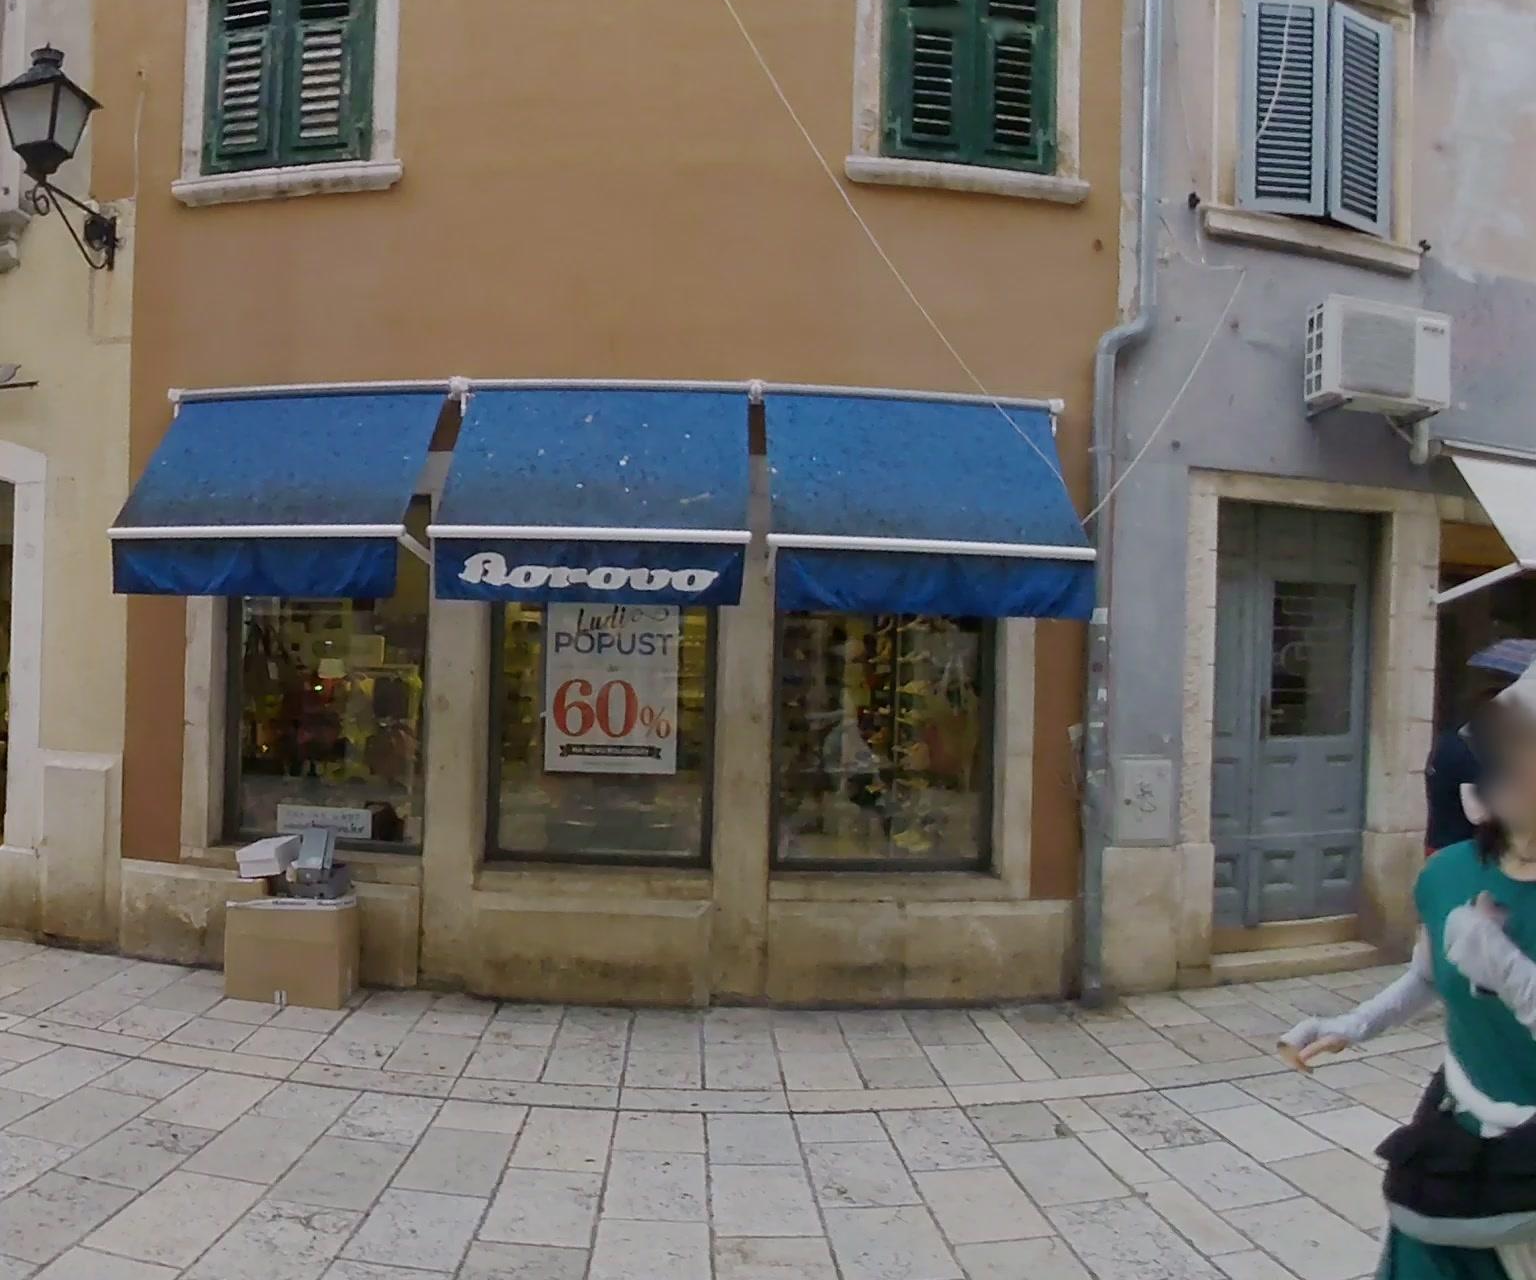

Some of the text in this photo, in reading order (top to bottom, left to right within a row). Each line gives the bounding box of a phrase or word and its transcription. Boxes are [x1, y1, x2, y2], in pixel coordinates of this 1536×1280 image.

[458, 552, 719, 591] Borovo
[577, 605, 626, 634] Ludi
[555, 631, 673, 656] POPUST
[552, 678, 672, 739] 60%
